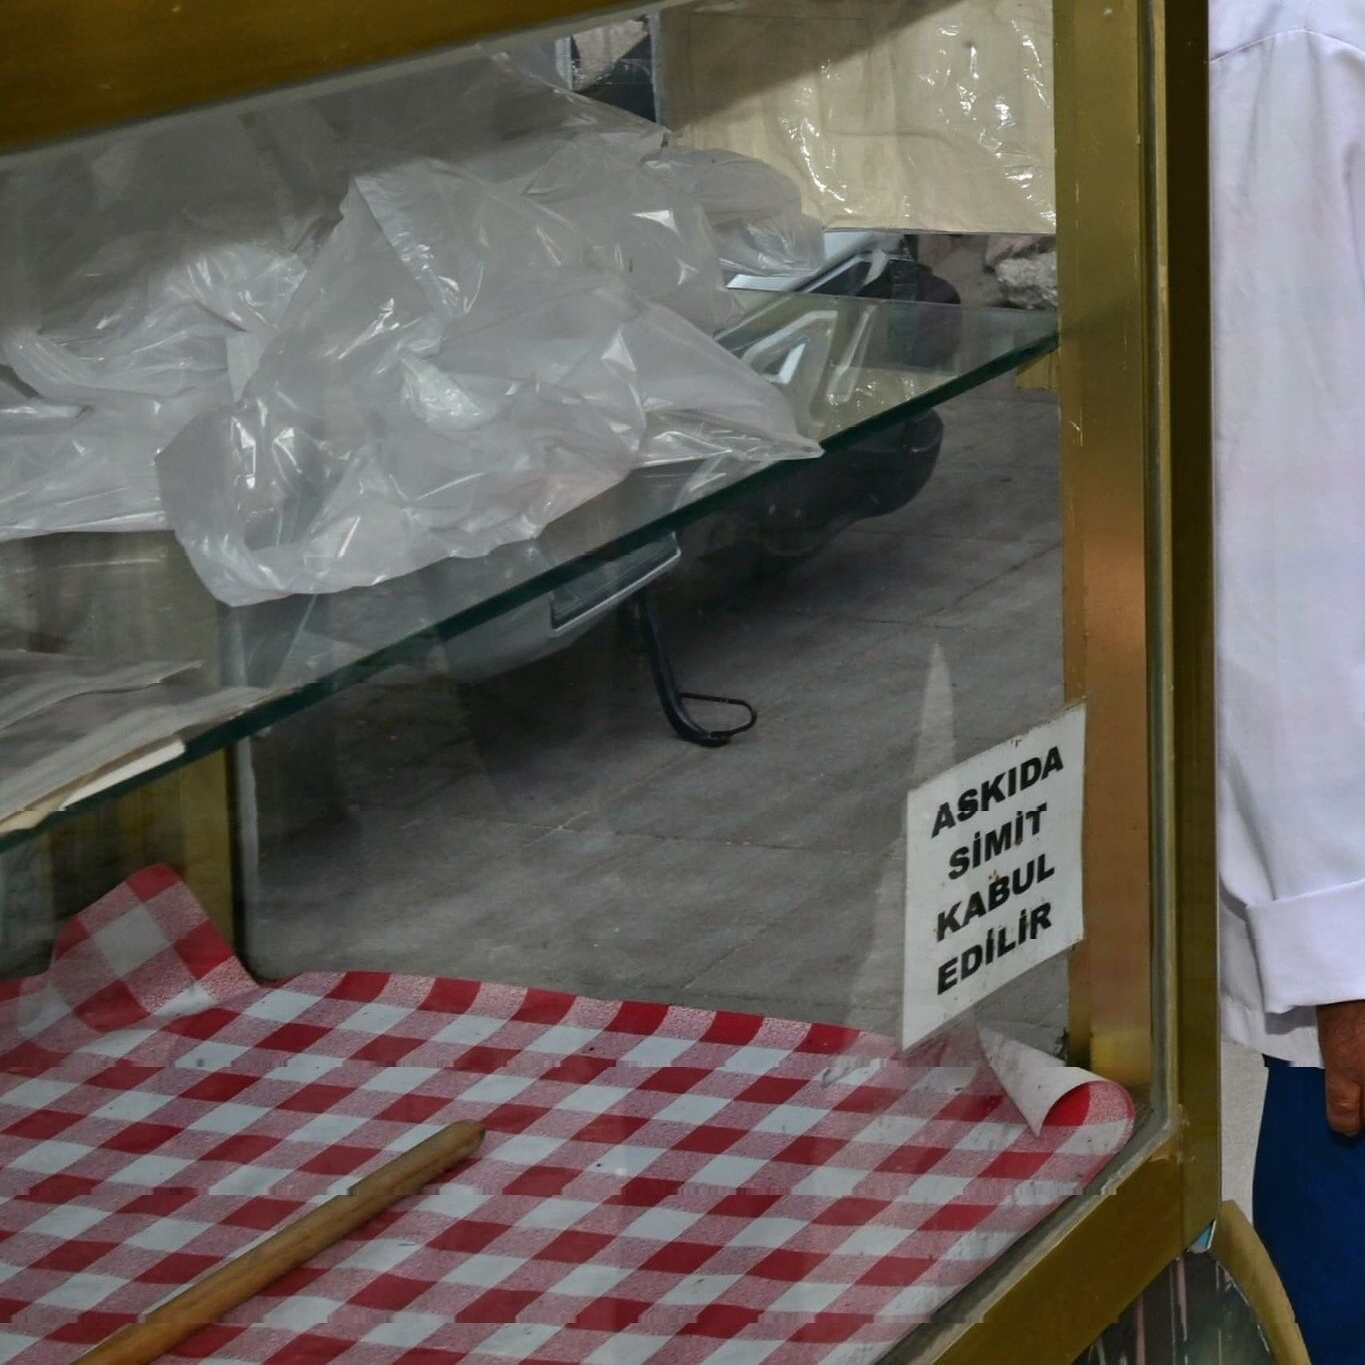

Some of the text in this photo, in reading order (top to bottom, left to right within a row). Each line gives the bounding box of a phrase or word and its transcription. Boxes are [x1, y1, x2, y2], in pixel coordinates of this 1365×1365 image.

[931, 746, 1064, 838] ASKIDA
[948, 803, 1047, 880] SİMİT
[936, 854, 1054, 942] KABUL
[937, 902, 1052, 995] EDİLİR
